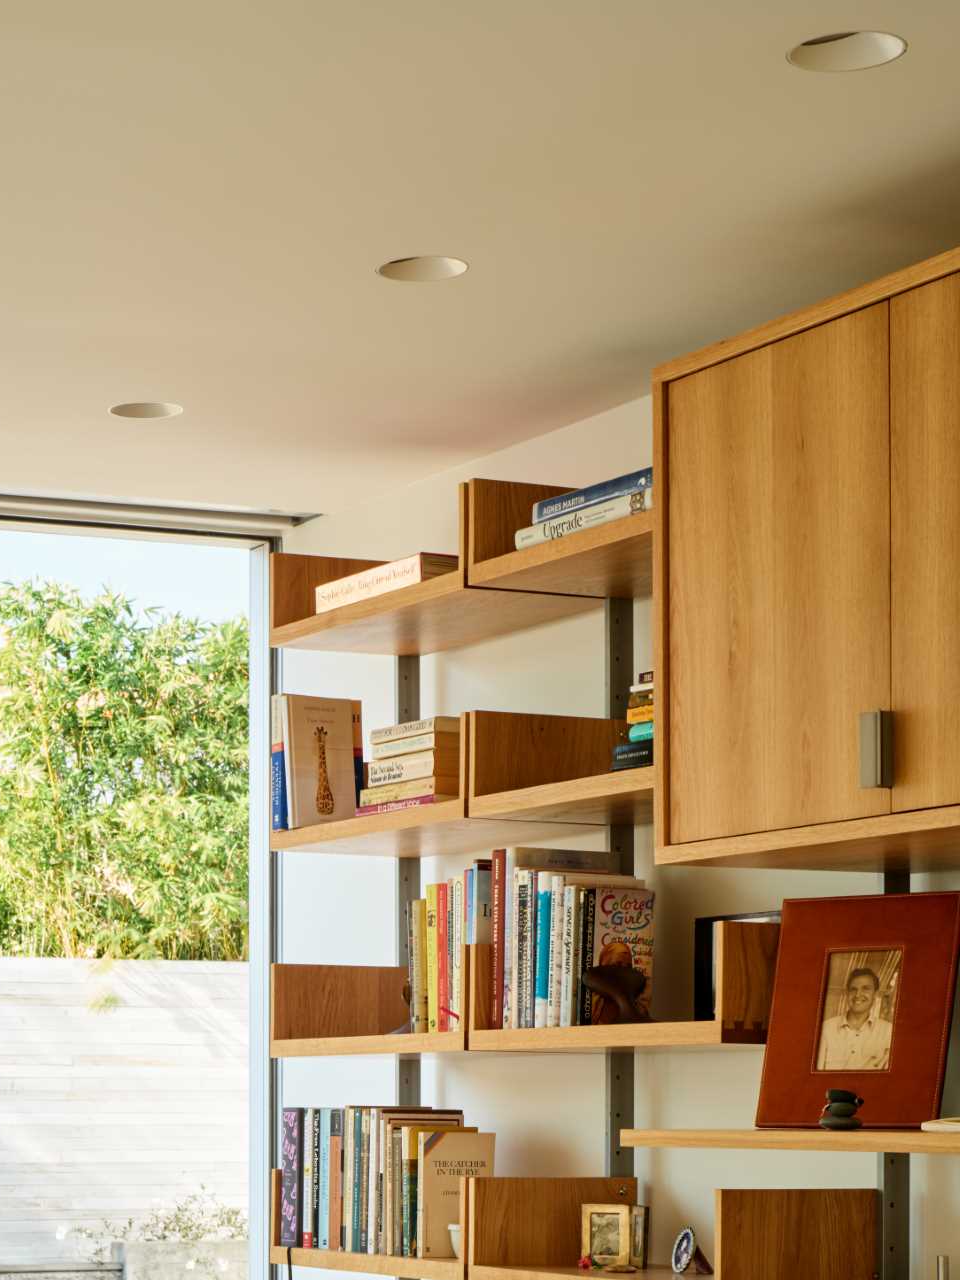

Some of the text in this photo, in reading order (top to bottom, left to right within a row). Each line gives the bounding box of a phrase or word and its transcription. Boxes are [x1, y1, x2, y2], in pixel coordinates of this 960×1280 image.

[542, 494, 585, 515] AGNES MARTIN
[542, 512, 583, 540] Upgrade
[601, 892, 656, 915] Colored
[610, 911, 651, 926] Girls
[432, 1160, 487, 1168] THE CATCHER
[436, 1168, 481, 1176] IN THE RYE
